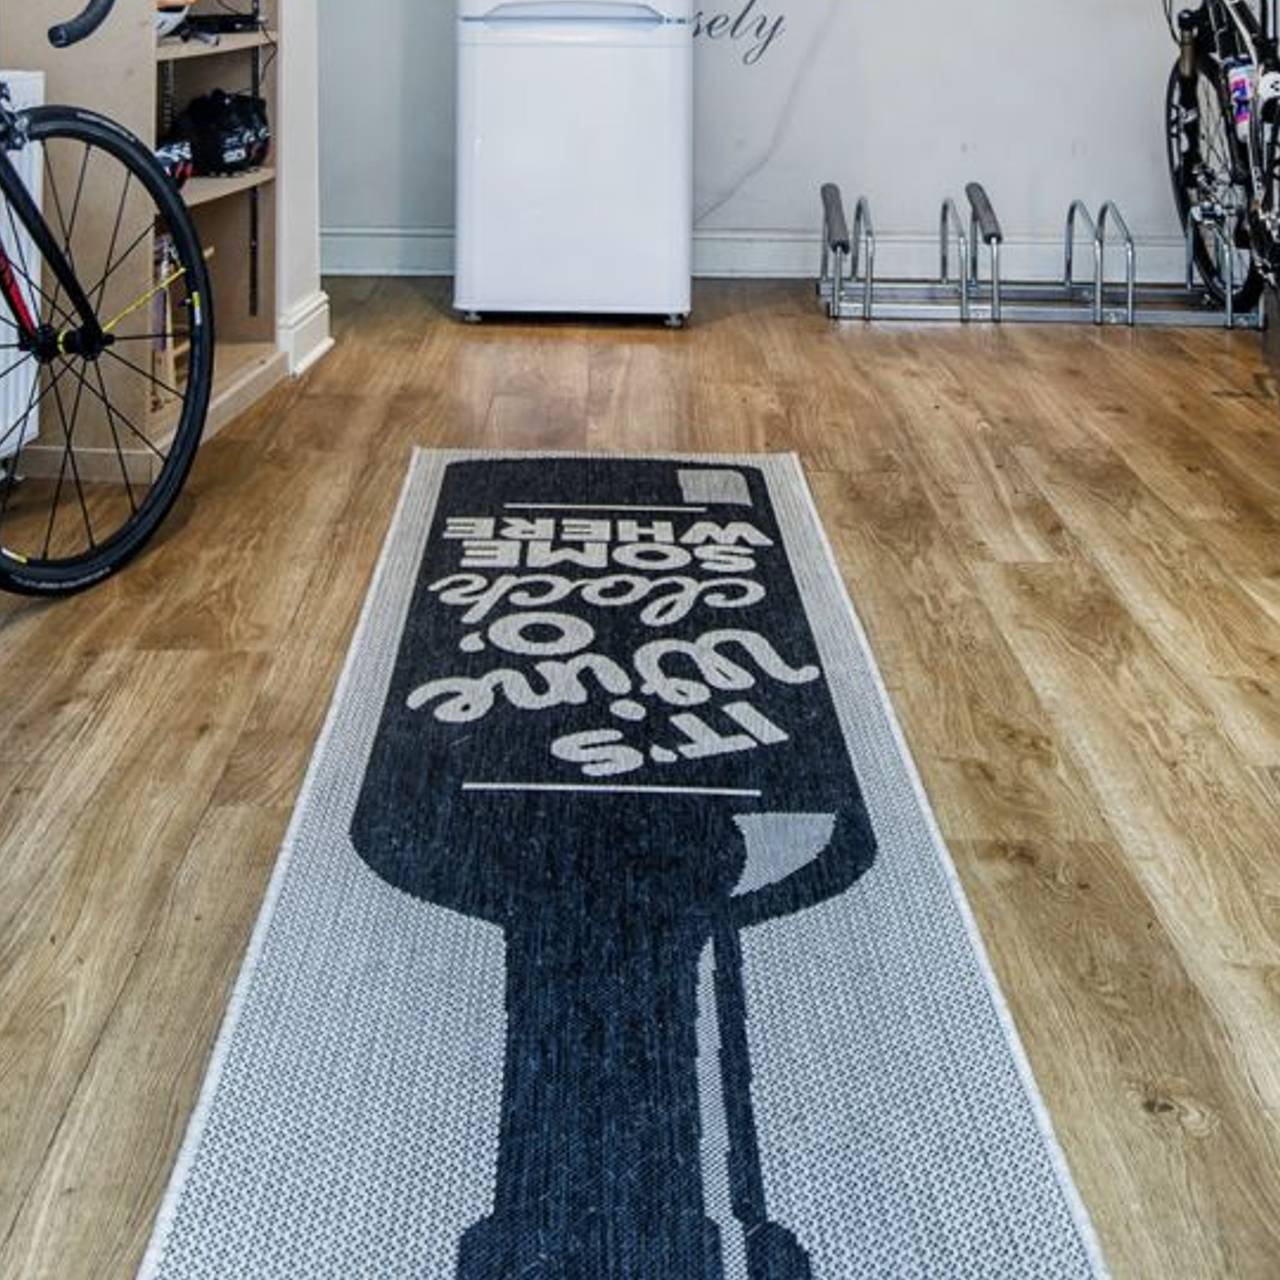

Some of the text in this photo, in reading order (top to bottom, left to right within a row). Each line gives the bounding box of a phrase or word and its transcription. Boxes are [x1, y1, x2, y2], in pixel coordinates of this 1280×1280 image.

[442, 516, 774, 547] WHERE
[460, 539, 756, 572] SOME
[428, 573, 766, 626] clock
[407, 629, 820, 722] Wine
[550, 700, 789, 776] IT'S
